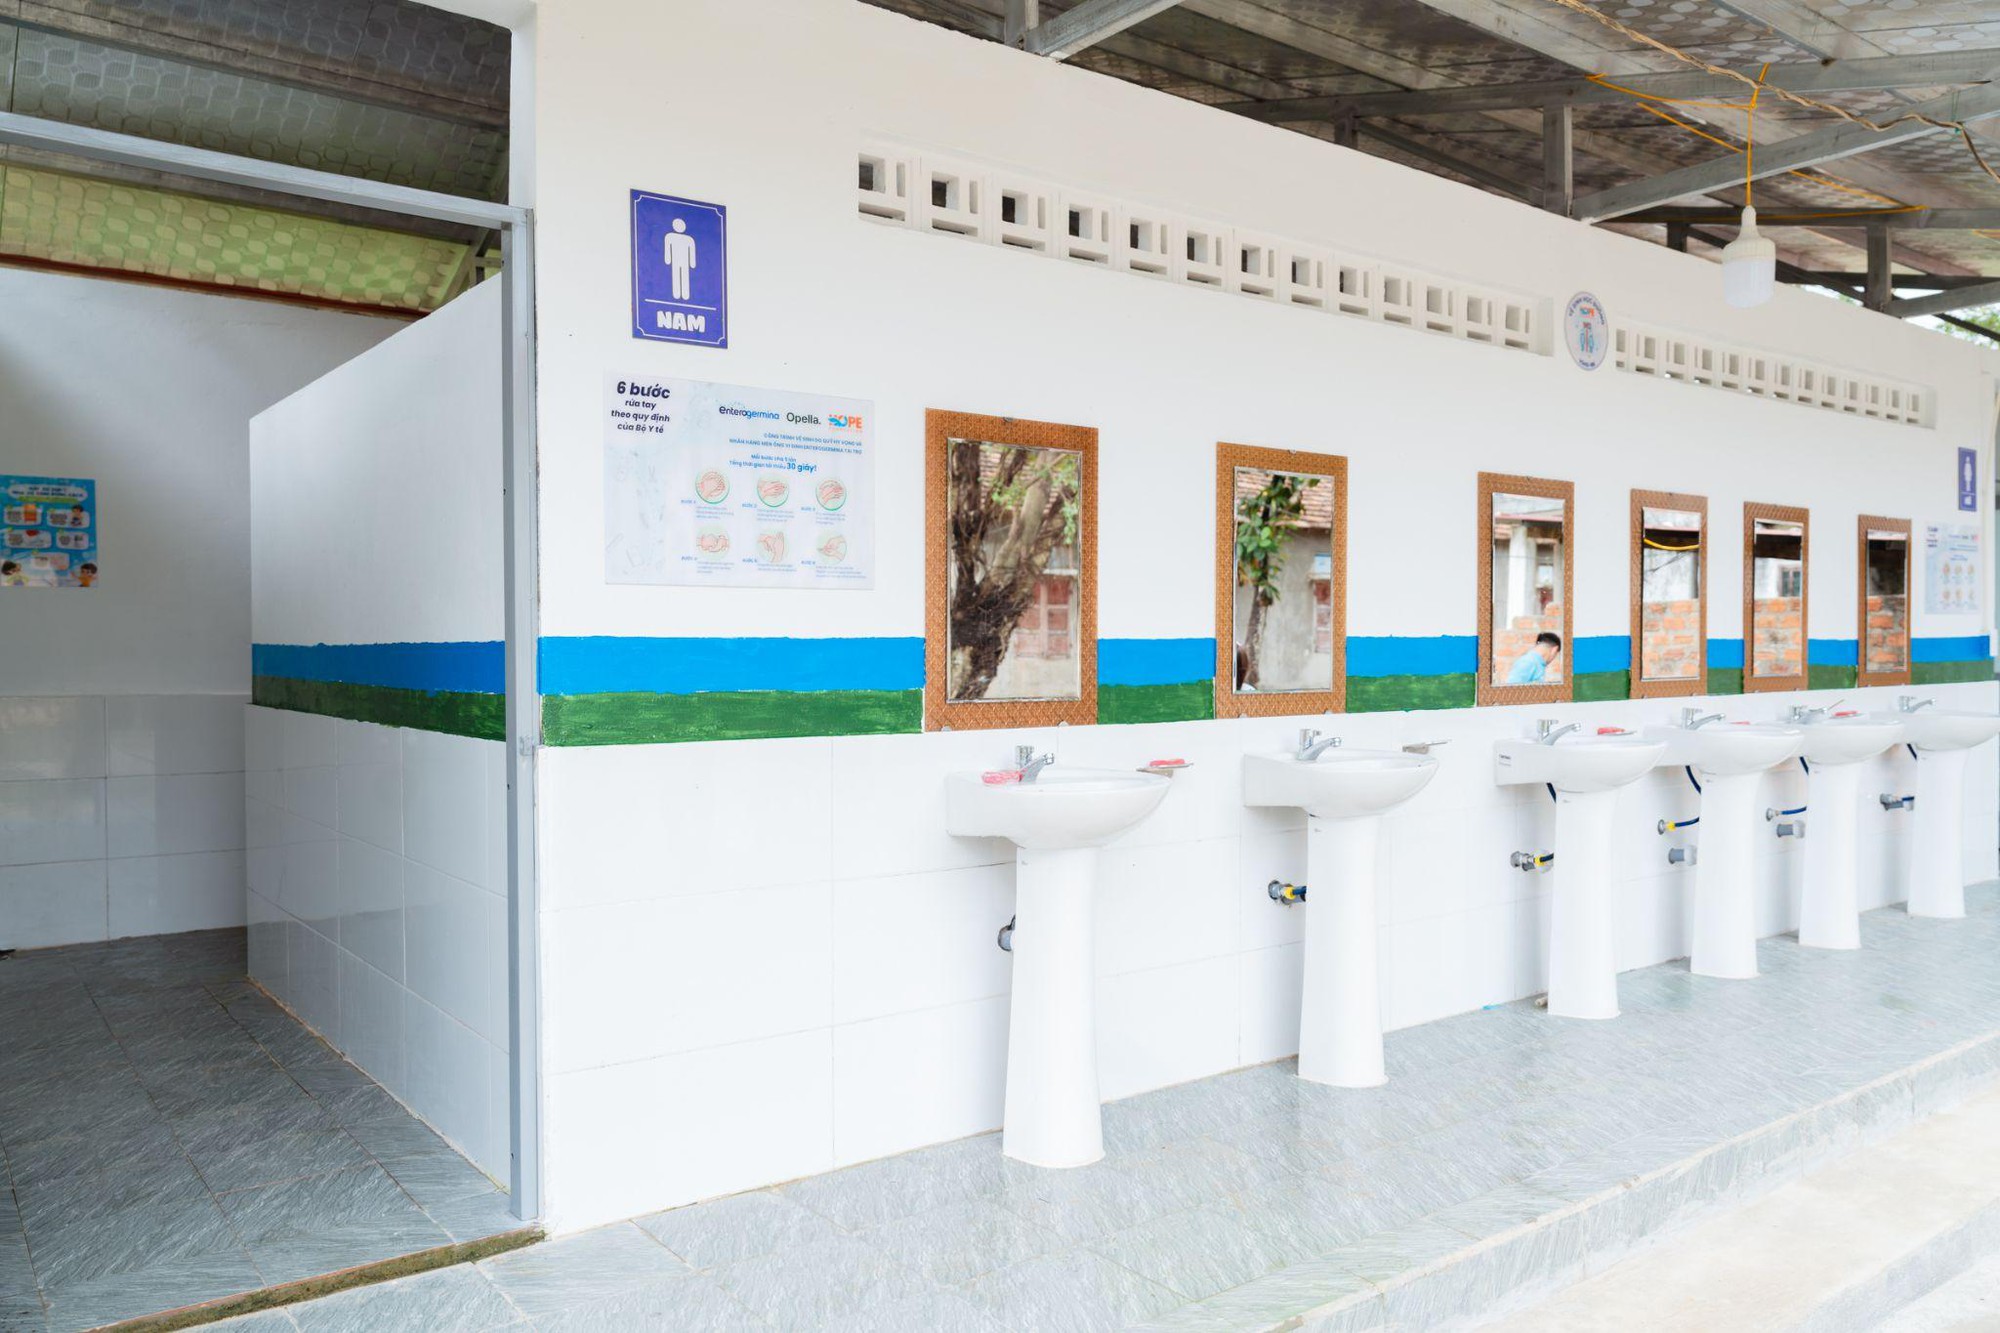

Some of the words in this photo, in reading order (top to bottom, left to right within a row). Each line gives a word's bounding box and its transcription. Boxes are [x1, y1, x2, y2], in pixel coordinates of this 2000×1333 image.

[656, 310, 706, 333] NAM
[617, 381, 626, 394] 6
[630, 382, 670, 399] bước
[625, 398, 640, 407] rửa
[642, 401, 657, 411] tay
[611, 410, 631, 419] theo
[632, 412, 649, 422] quy
[650, 413, 670, 423] định
[719, 405, 780, 420] enterogermina
[617, 422, 634, 431] của
[635, 423, 647, 434] Bộ
[655, 424, 665, 434] tế
[787, 462, 796, 470] 30
[797, 463, 817, 473] giây!
